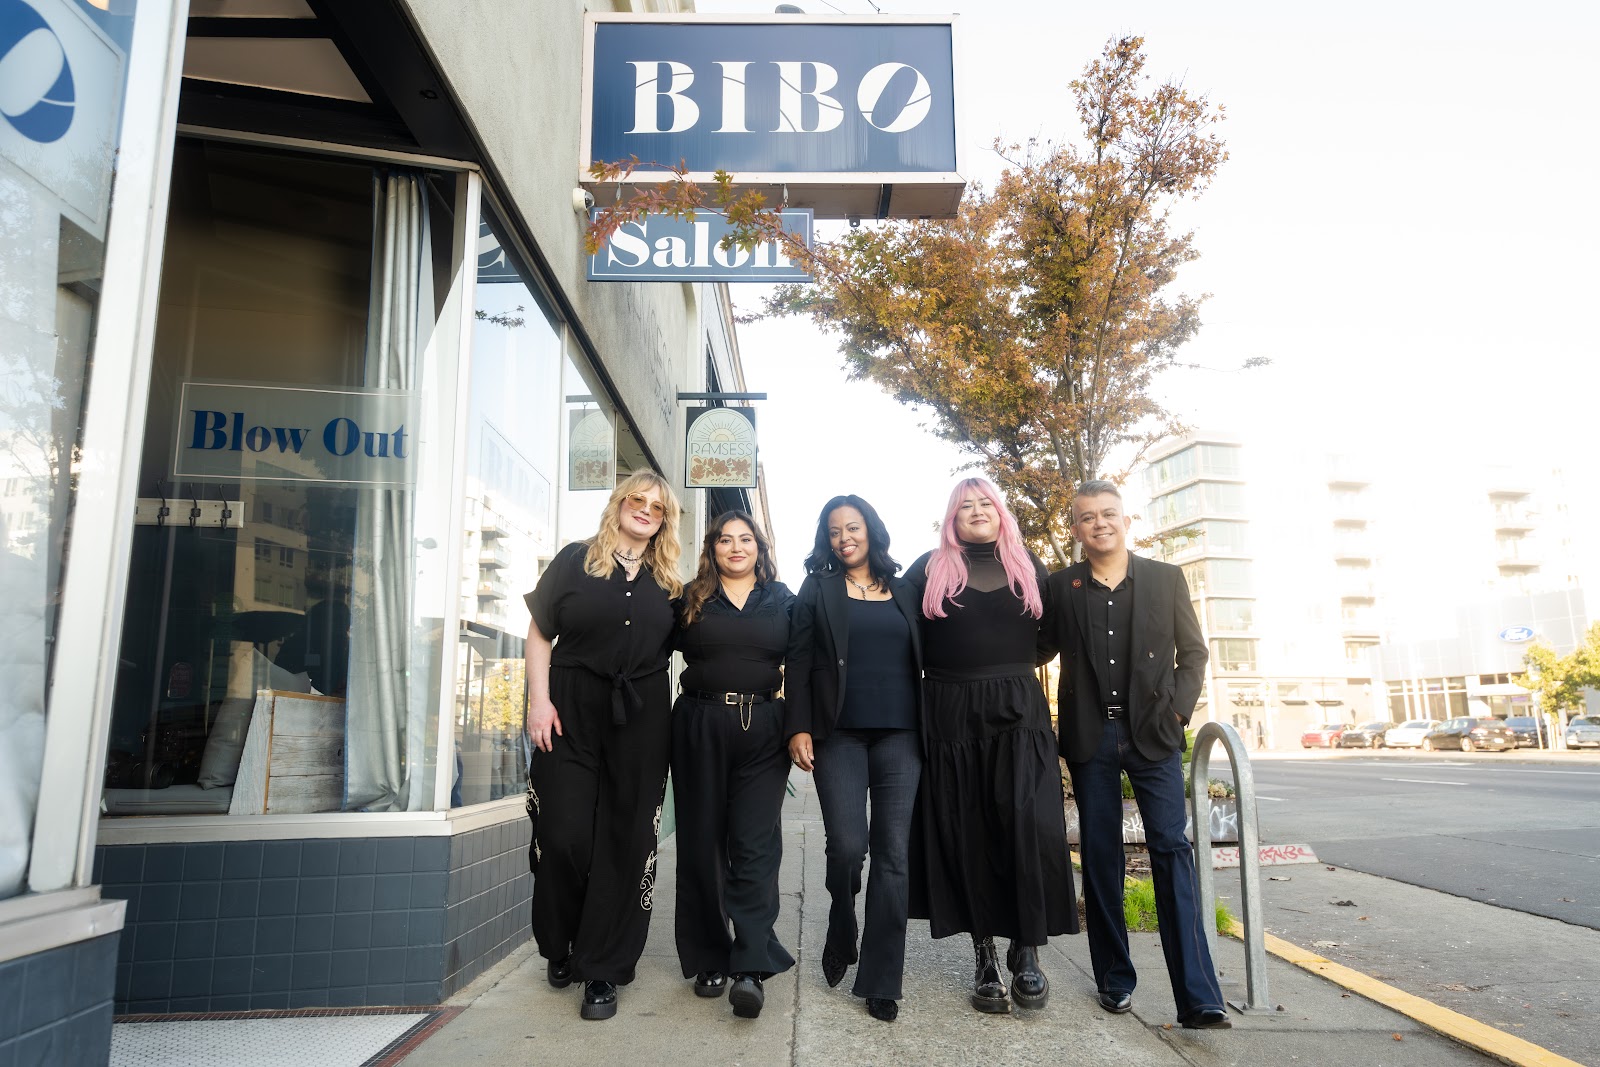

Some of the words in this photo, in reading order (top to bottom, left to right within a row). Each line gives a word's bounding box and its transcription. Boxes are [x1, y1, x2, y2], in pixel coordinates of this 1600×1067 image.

[624, 61, 932, 133] BIBO
[607, 220, 796, 269] Salon
[187, 409, 311, 454] Blow
[322, 417, 410, 459] Out
[690, 442, 753, 456] RAMSESS
